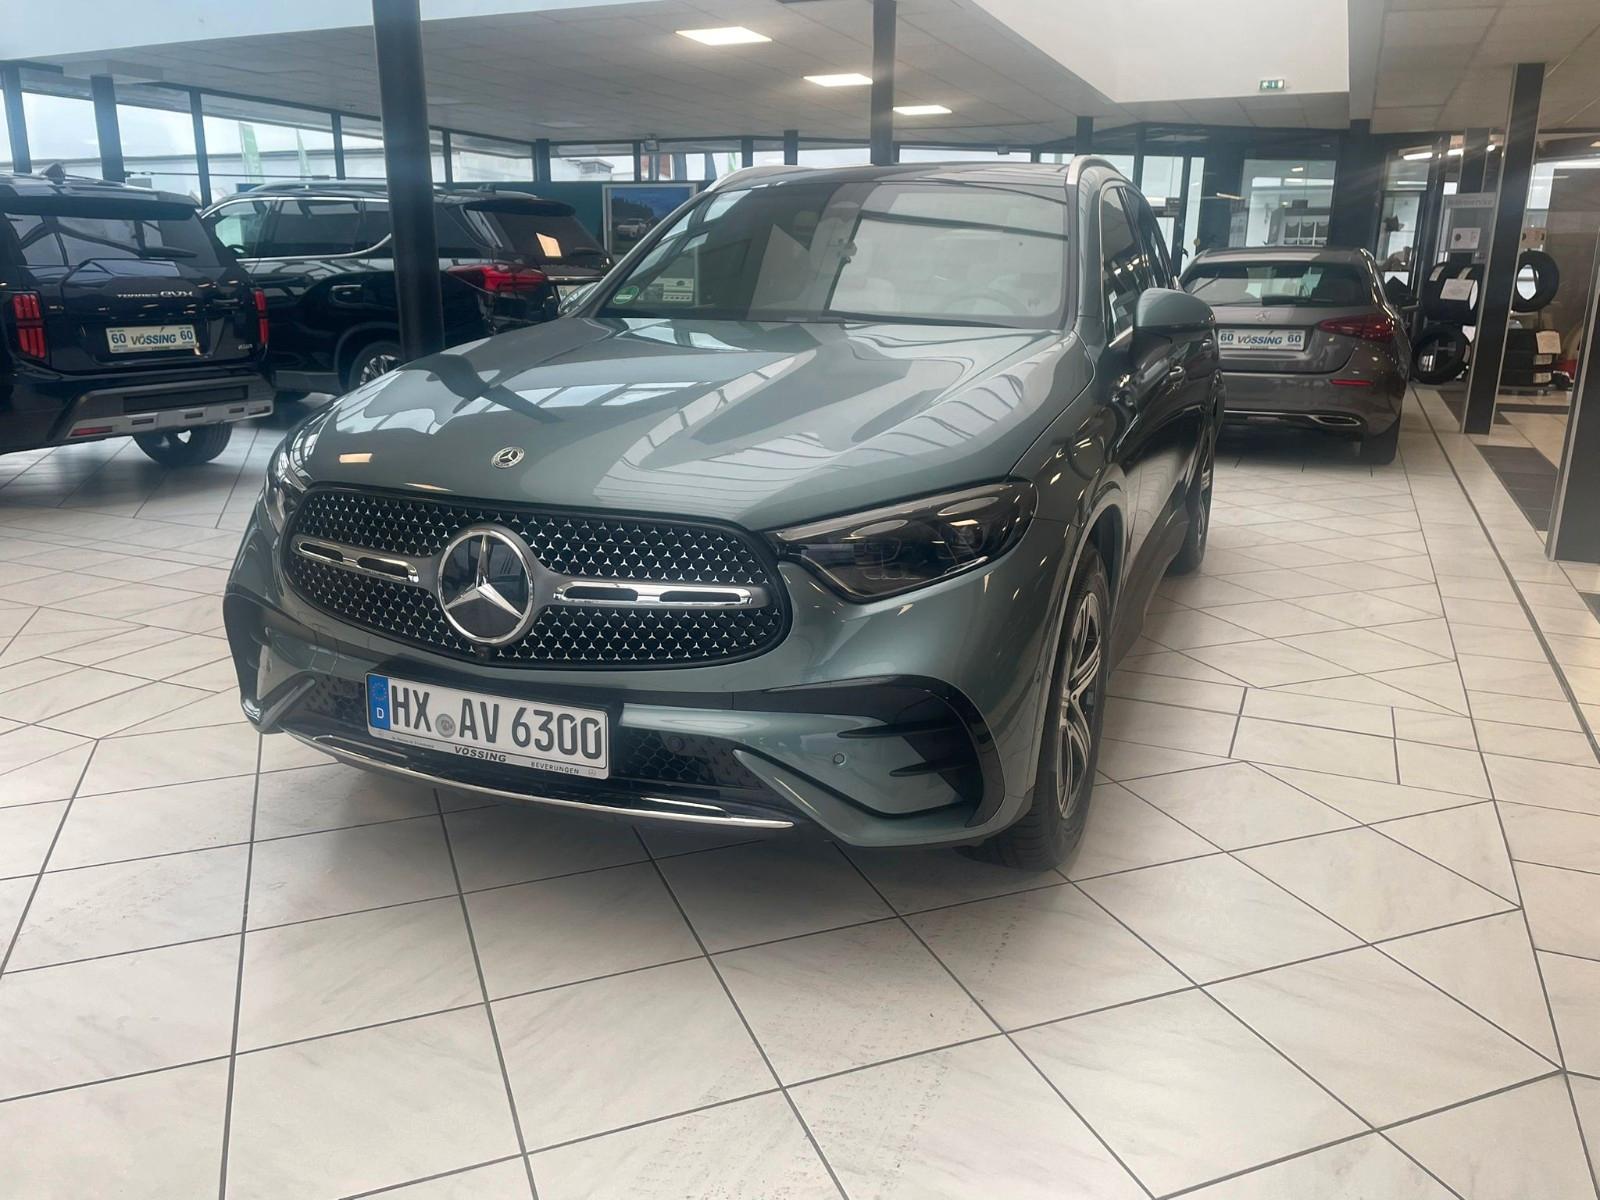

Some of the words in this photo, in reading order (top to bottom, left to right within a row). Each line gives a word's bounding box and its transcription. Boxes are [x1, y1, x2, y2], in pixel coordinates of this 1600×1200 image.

[111, 333, 127, 344] 60
[180, 330, 193, 341] 60
[1220, 333, 1234, 342] 60
[1287, 334, 1302, 343] 60
[376, 707, 385, 719] D
[391, 685, 432, 732] HX
[459, 698, 500, 743] AV
[511, 707, 601, 760] 6300
[531, 762, 579, 774] BEVERUNGEN
